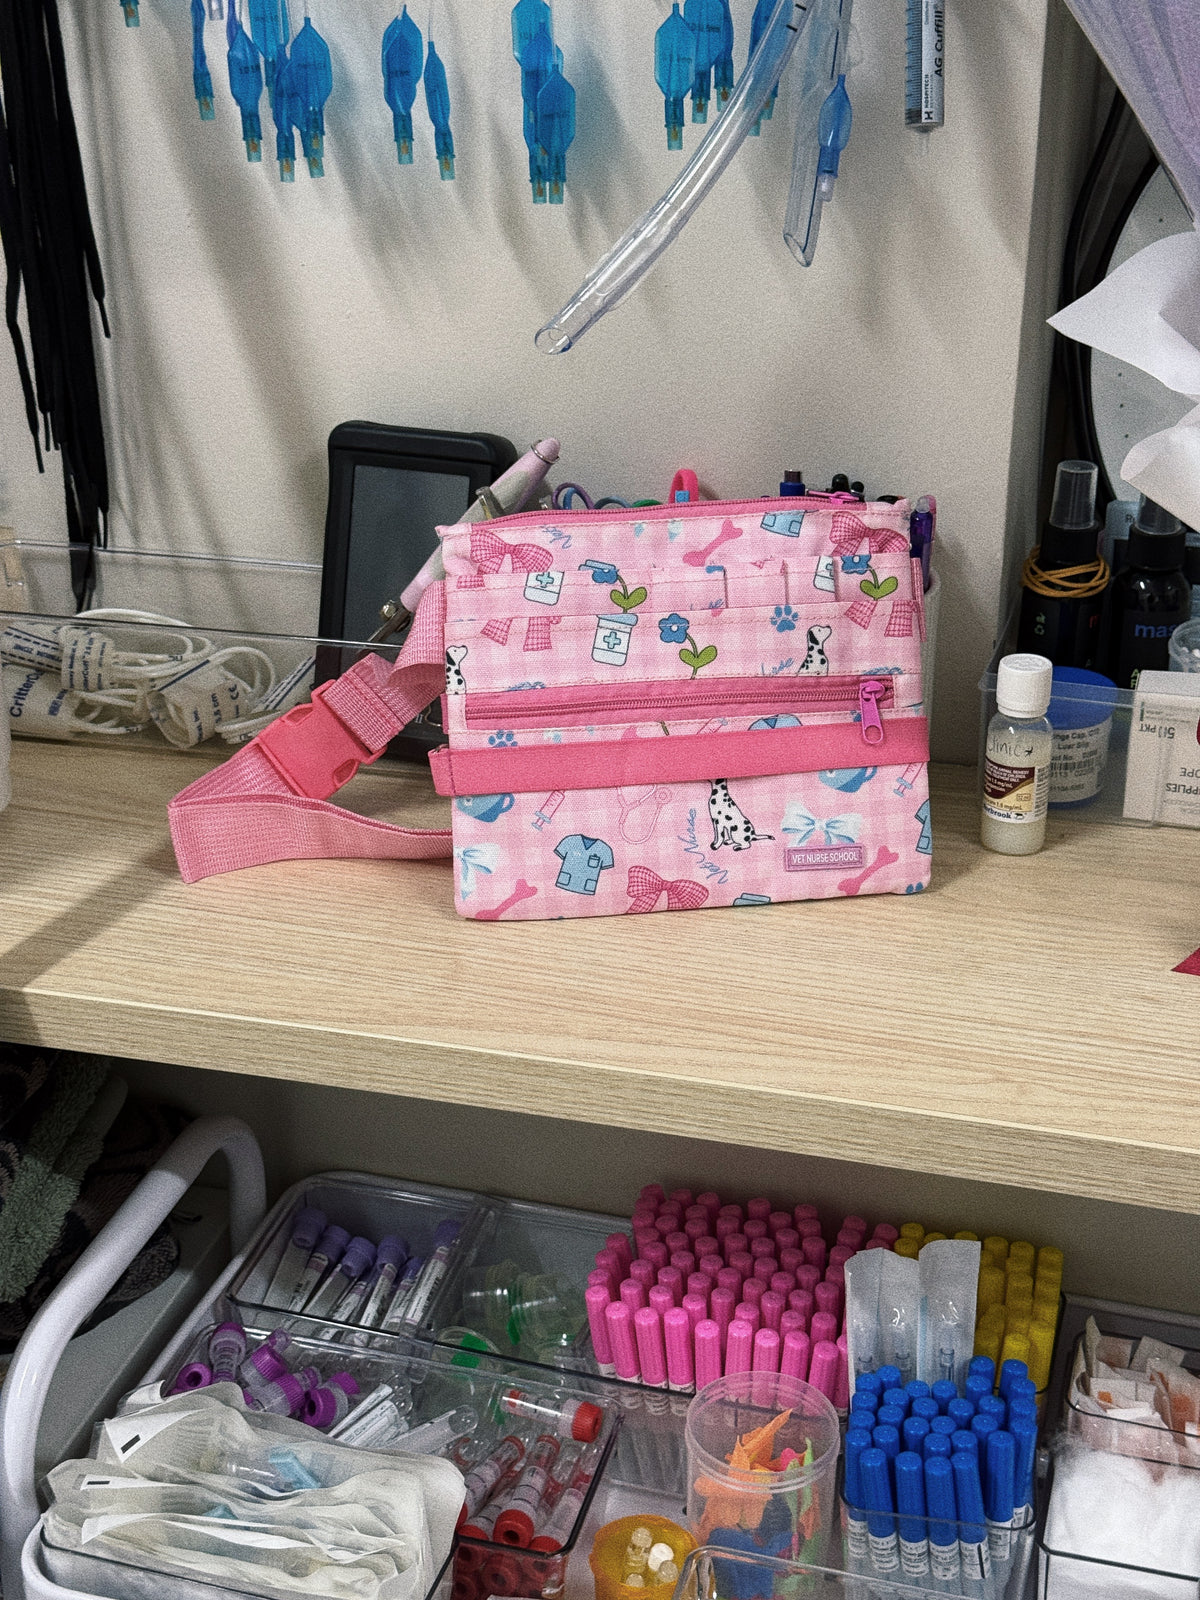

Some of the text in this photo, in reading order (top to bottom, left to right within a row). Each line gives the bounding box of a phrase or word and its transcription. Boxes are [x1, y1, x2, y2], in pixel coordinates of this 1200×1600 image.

[934, 10, 944, 77] AG Cuffill
[1139, 722, 1156, 734] PKT
[1165, 782, 1200, 795] PPLIES
[792, 851, 858, 864] VET NURSE SCHOOL
